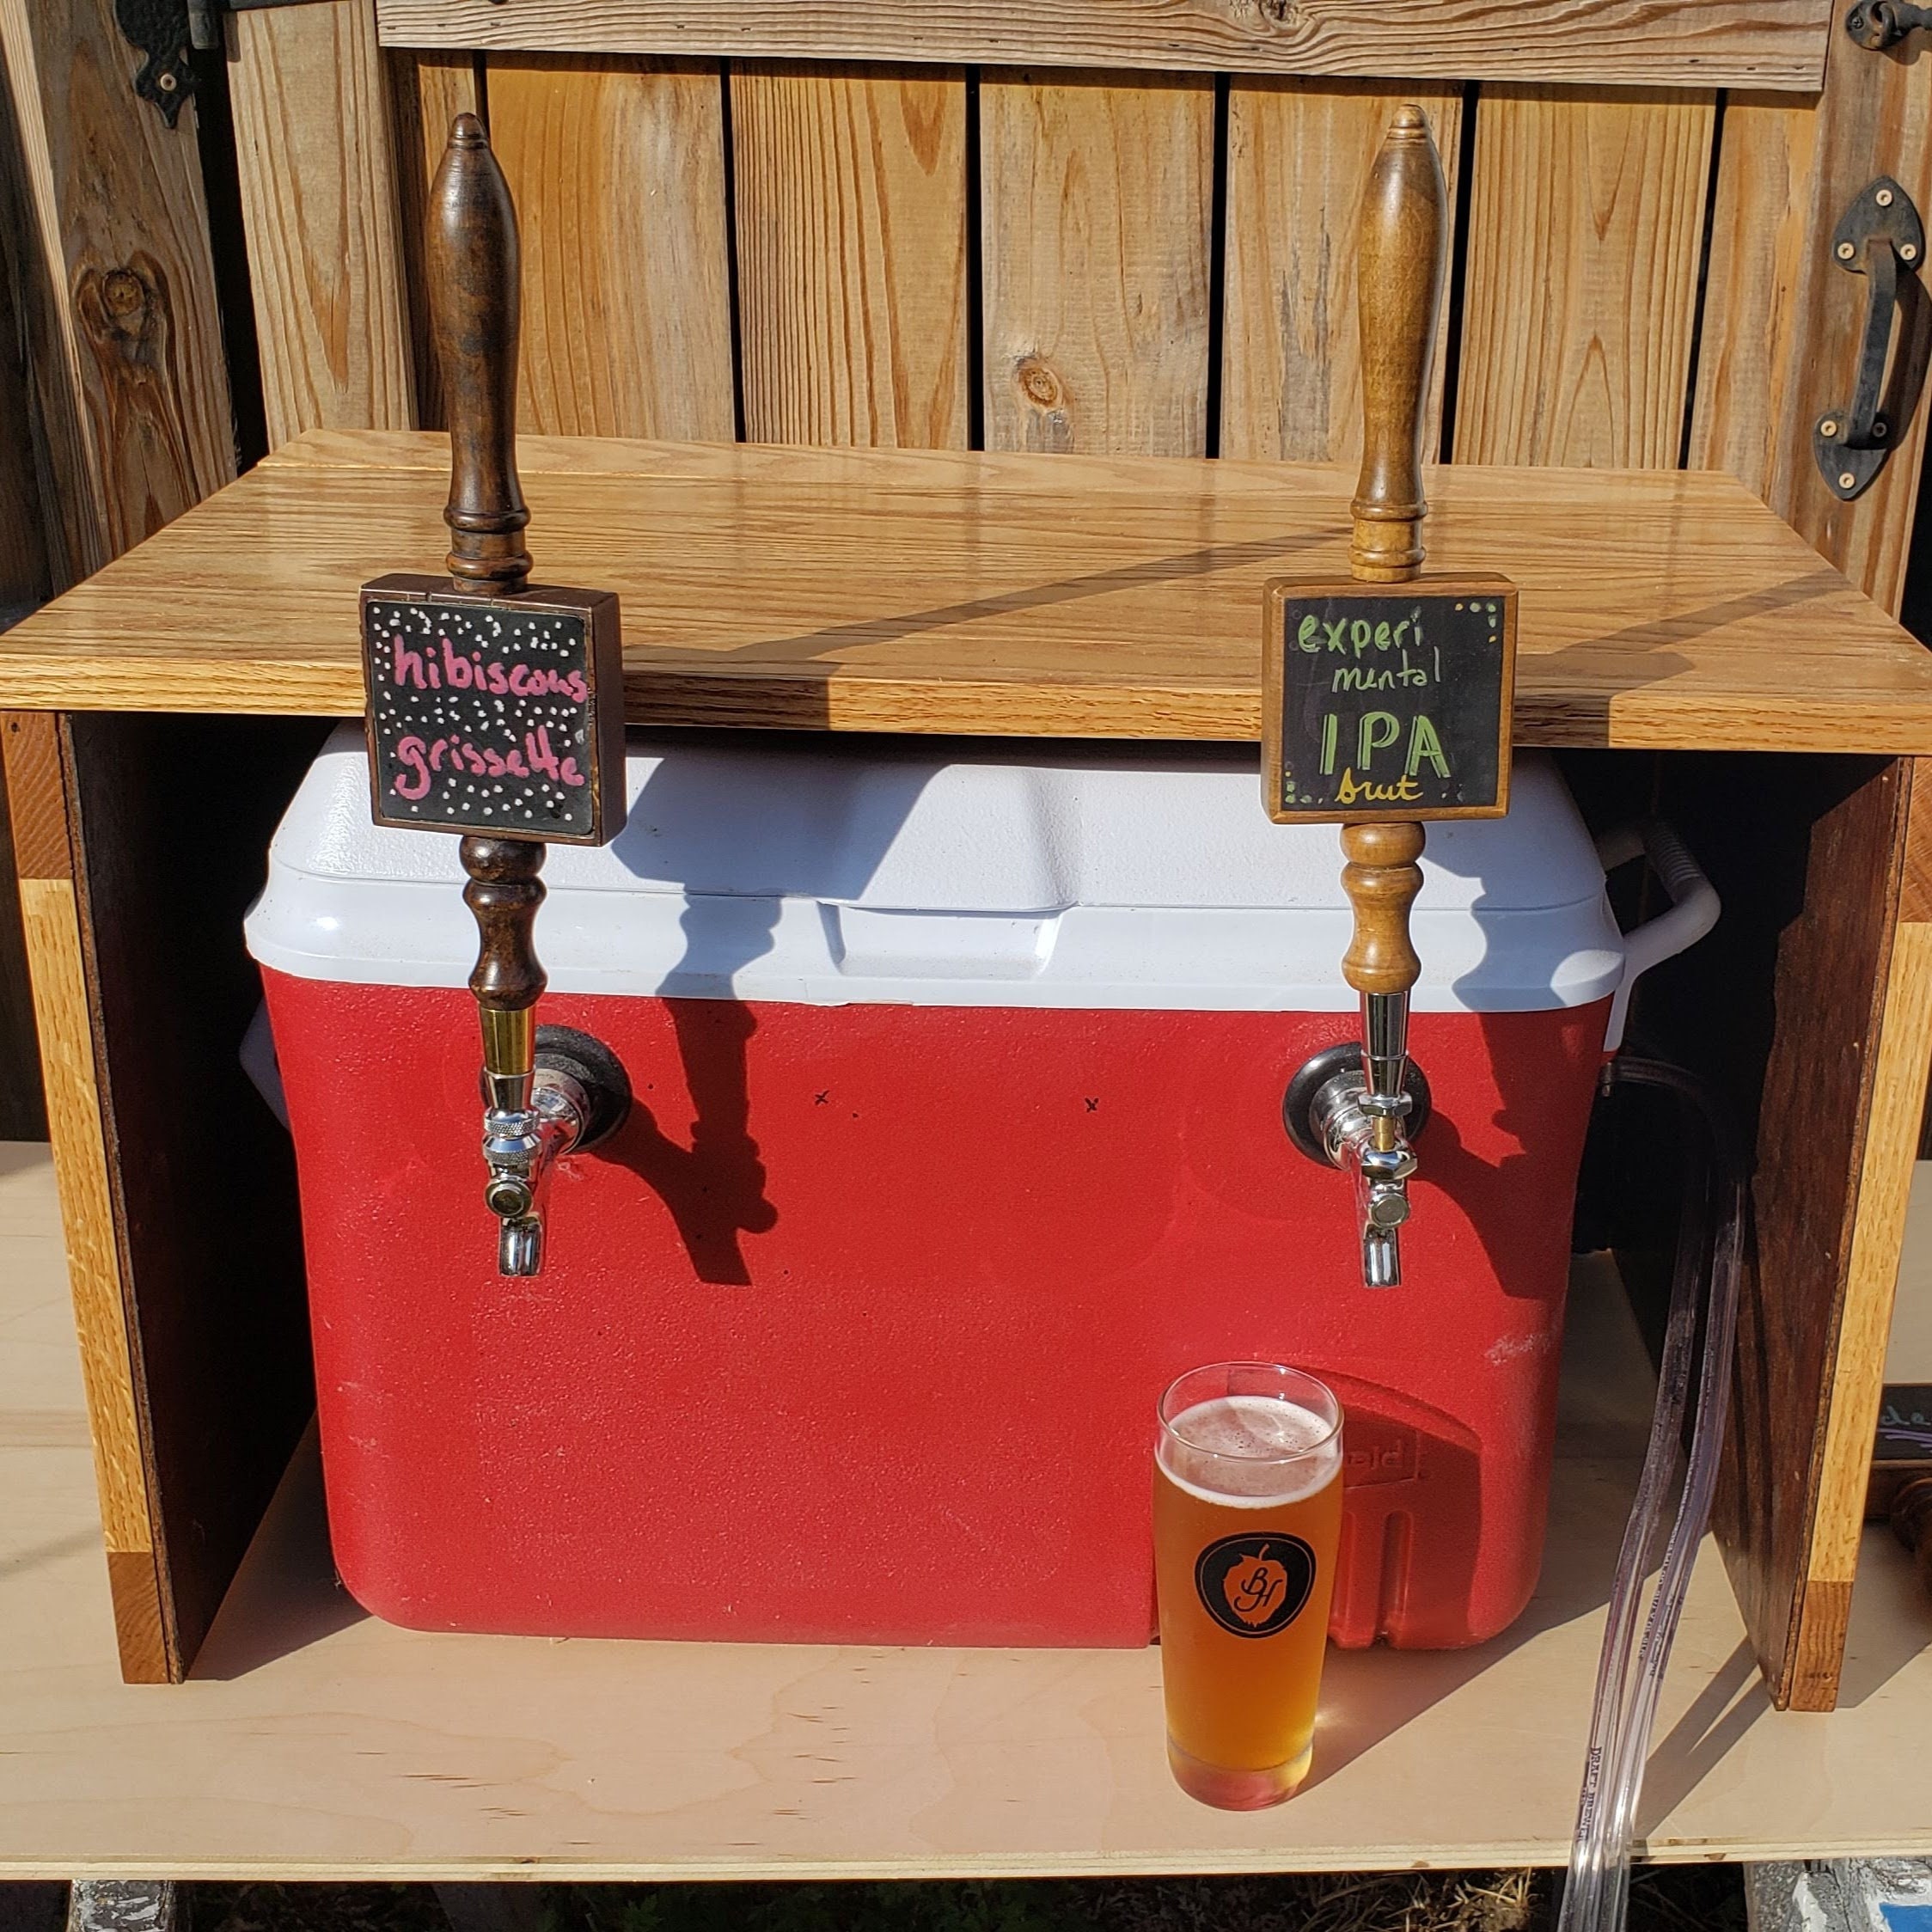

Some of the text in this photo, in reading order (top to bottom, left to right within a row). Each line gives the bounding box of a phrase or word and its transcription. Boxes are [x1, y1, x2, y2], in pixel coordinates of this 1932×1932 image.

[394, 725, 585, 800] grissette
[1320, 712, 1451, 778] IPA
[1334, 767, 1423, 804] brut
